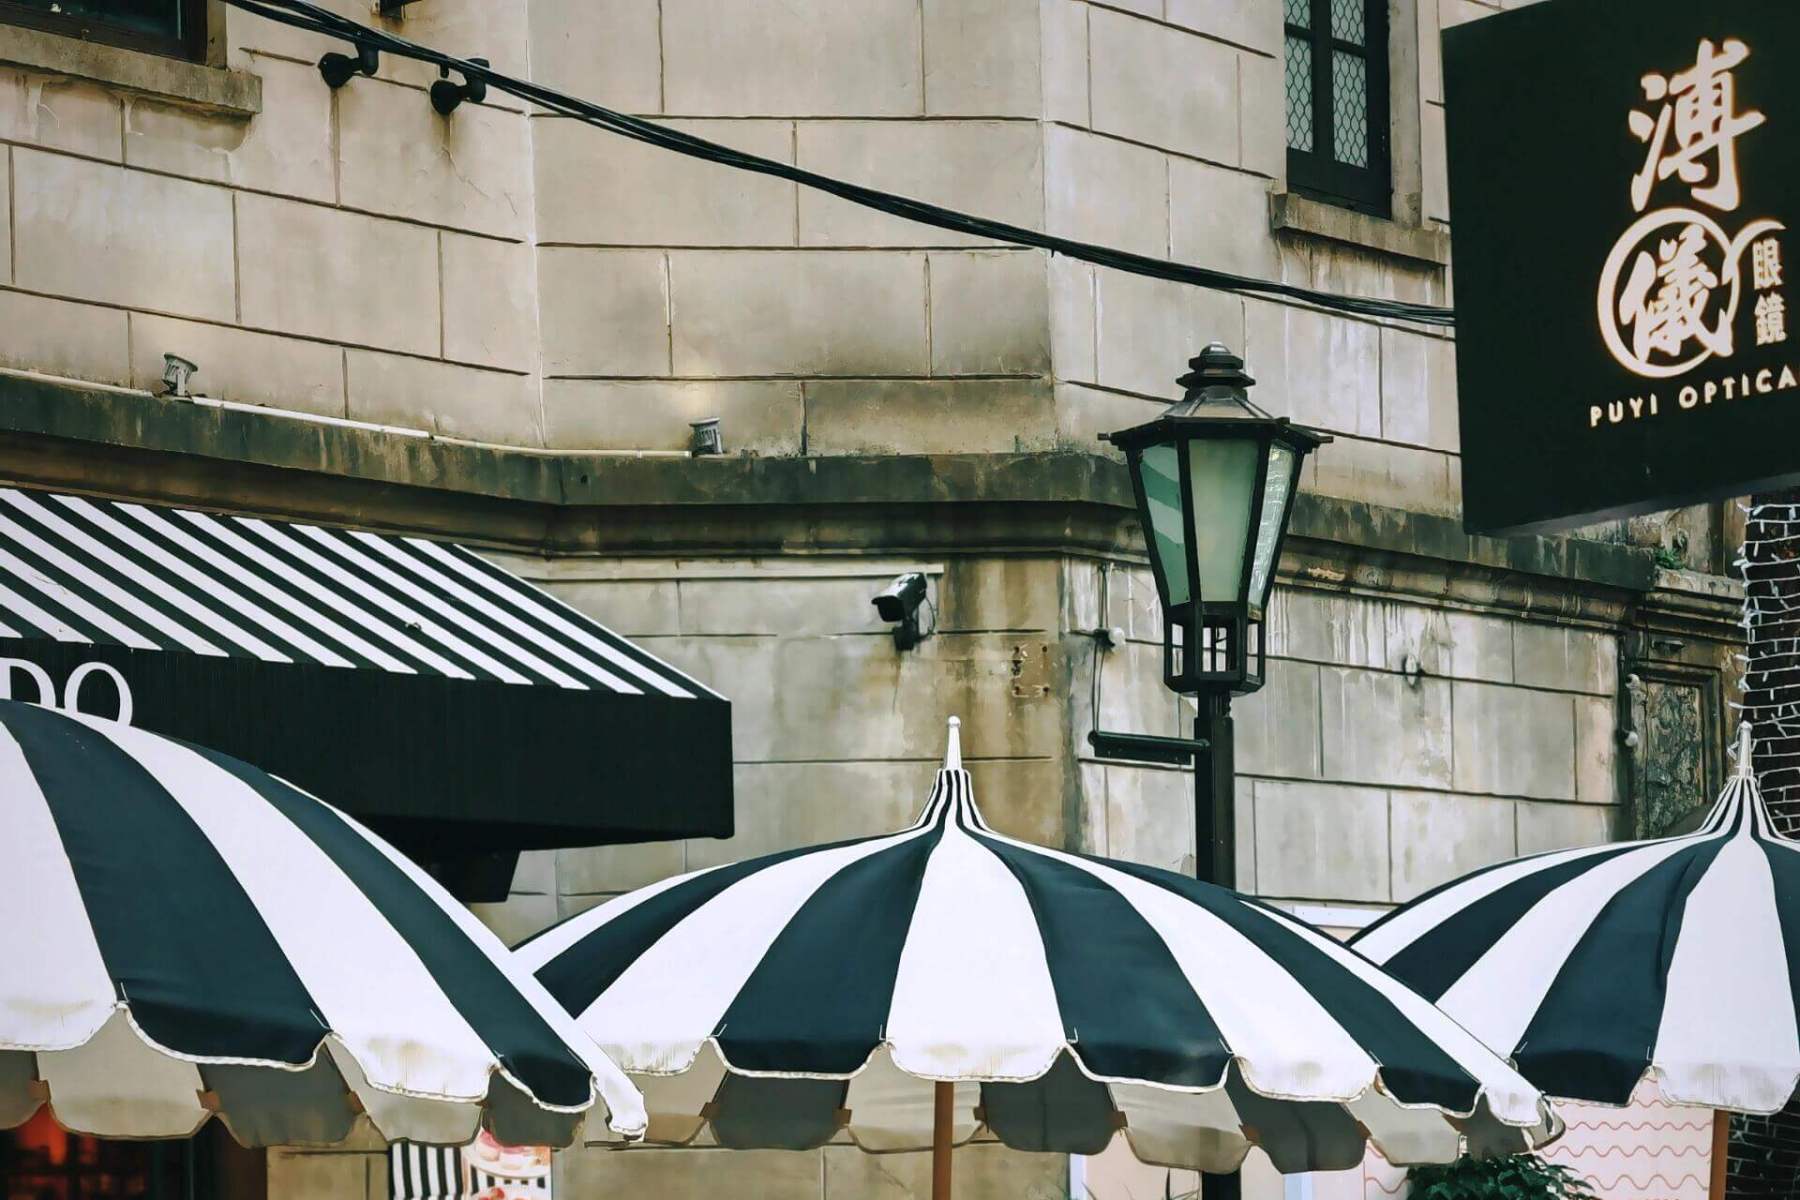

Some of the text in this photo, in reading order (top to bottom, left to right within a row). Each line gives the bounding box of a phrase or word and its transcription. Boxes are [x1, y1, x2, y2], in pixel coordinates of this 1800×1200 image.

[1752, 238, 1787, 346] 眼鏡
[1590, 364, 1799, 428] PUYI OPTICA
